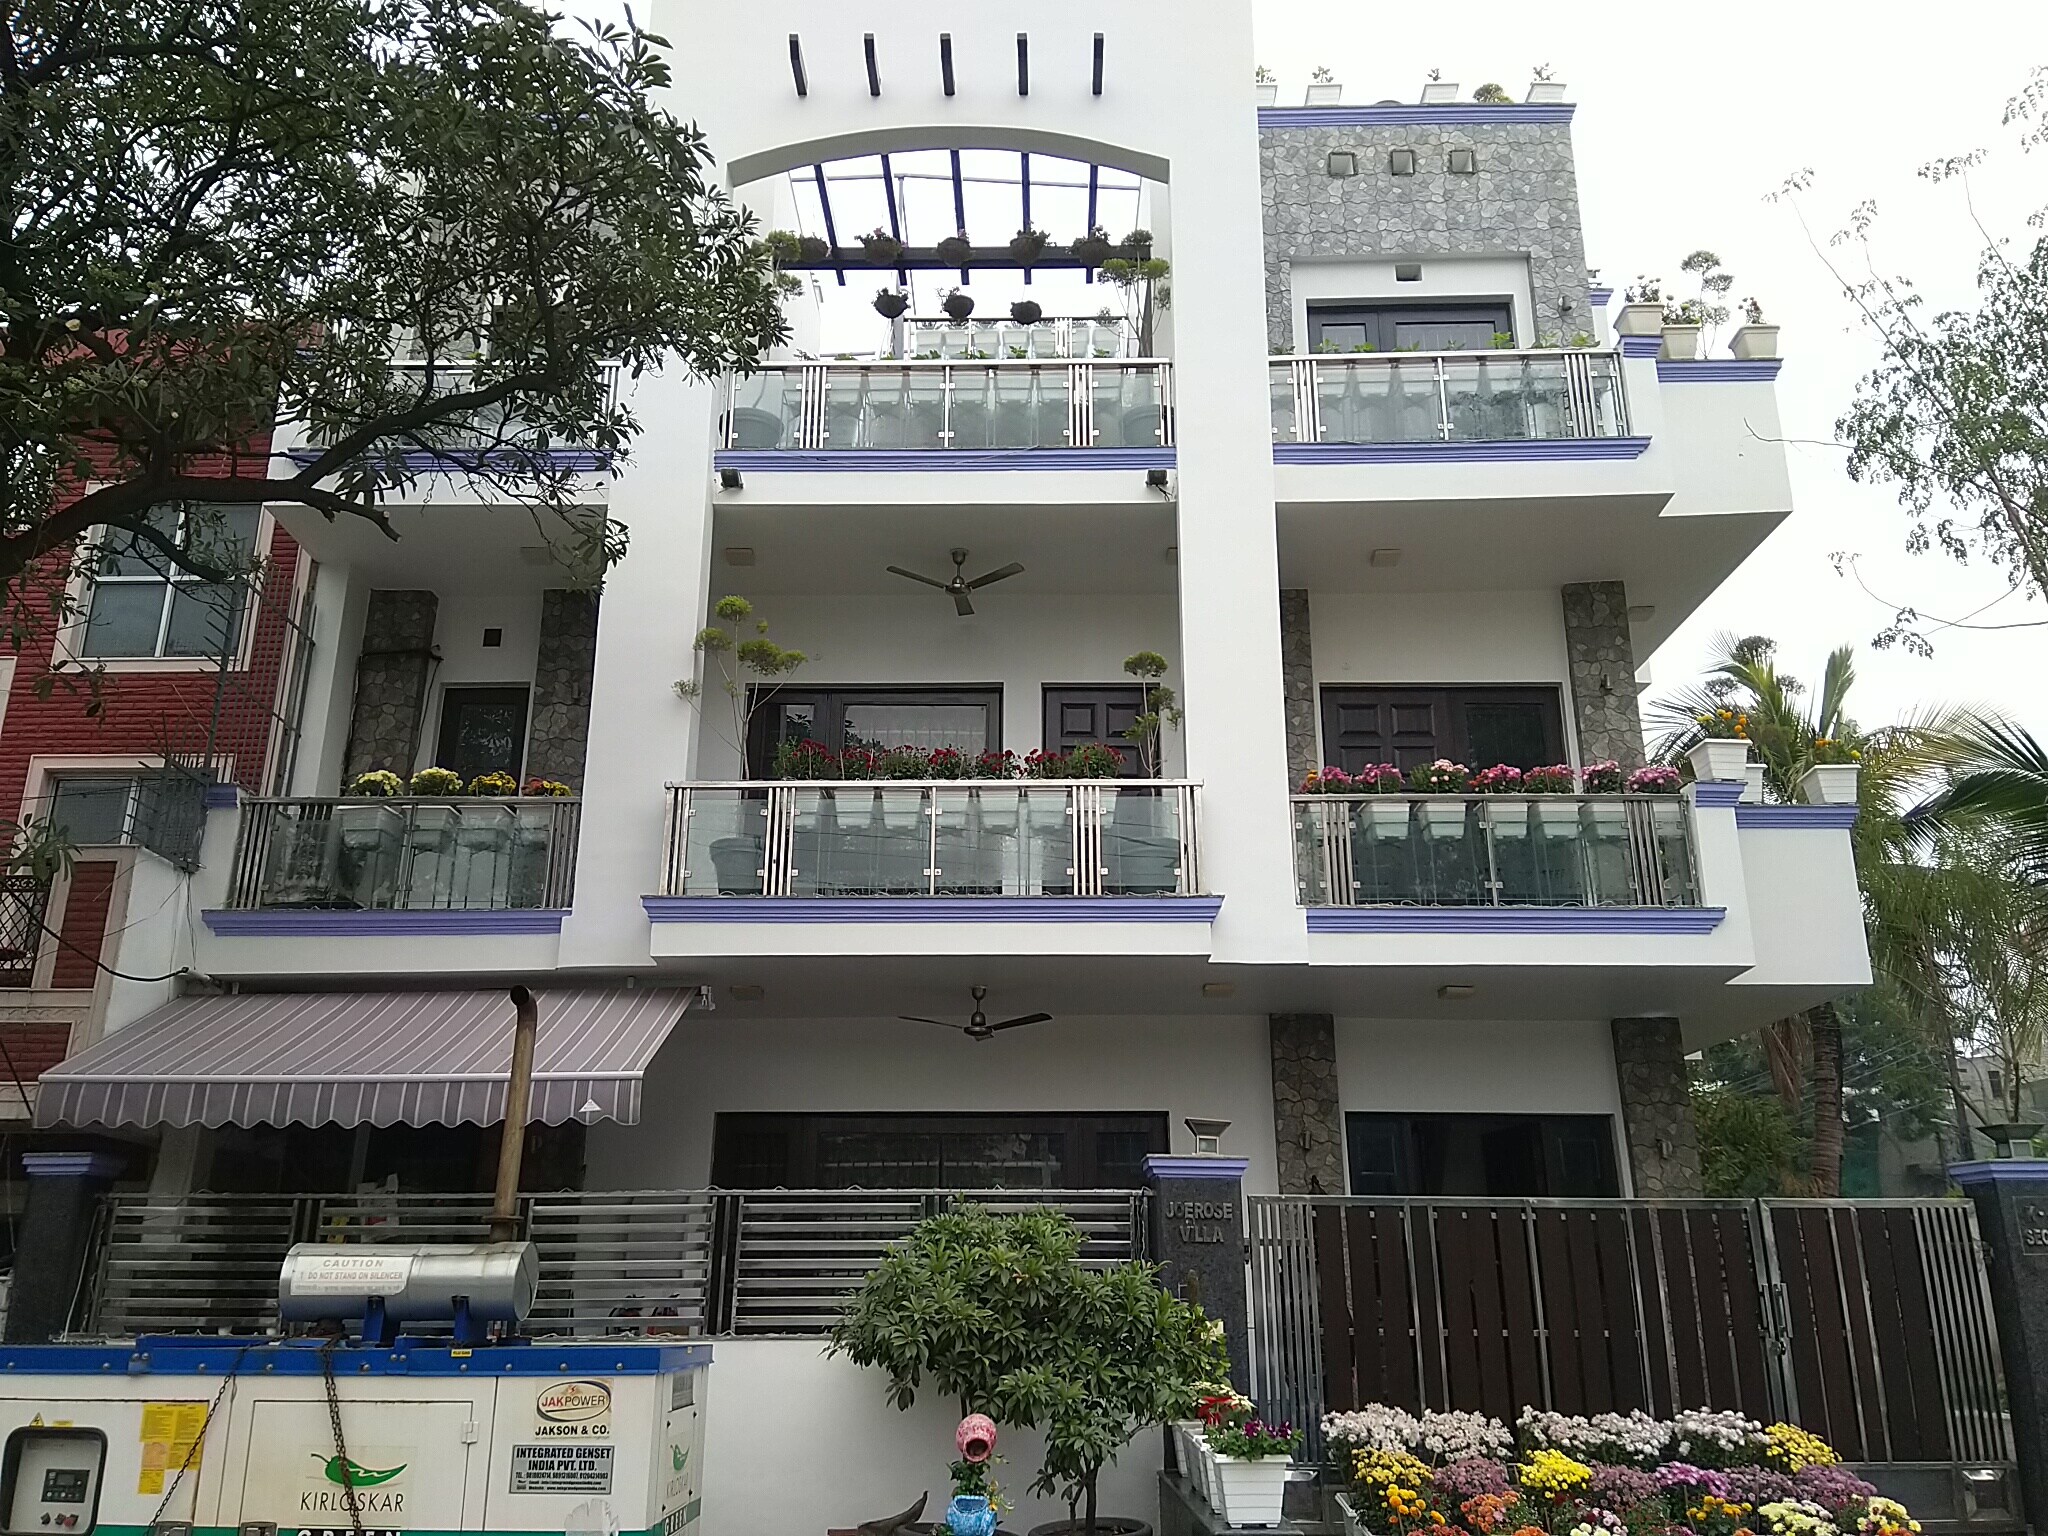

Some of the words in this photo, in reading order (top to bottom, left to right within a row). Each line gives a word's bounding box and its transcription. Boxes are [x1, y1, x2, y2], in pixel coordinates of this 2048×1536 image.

[1165, 1201, 1233, 1219] JOEROSE
[323, 1259, 384, 1268] CAUTION
[308, 1271, 317, 1280] DO
[319, 1271, 333, 1280] NOT
[335, 1271, 357, 1280] STAND
[358, 1271, 368, 1280] ON
[369, 1271, 403, 1280] SILENCER
[541, 1395, 605, 1407] JAKPOWER
[535, 1425, 578, 1436] JAKSON
[581, 1425, 588, 1435] &
[592, 1424, 610, 1435] CO.
[516, 1447, 574, 1458] INTEGRATED
[576, 1447, 612, 1459] GENSET
[528, 1460, 555, 1471] INDIA
[557, 1460, 576, 1471] PVT.
[578, 1460, 597, 1471] LTD.
[300, 1491, 404, 1512] KIRLOSKAR
